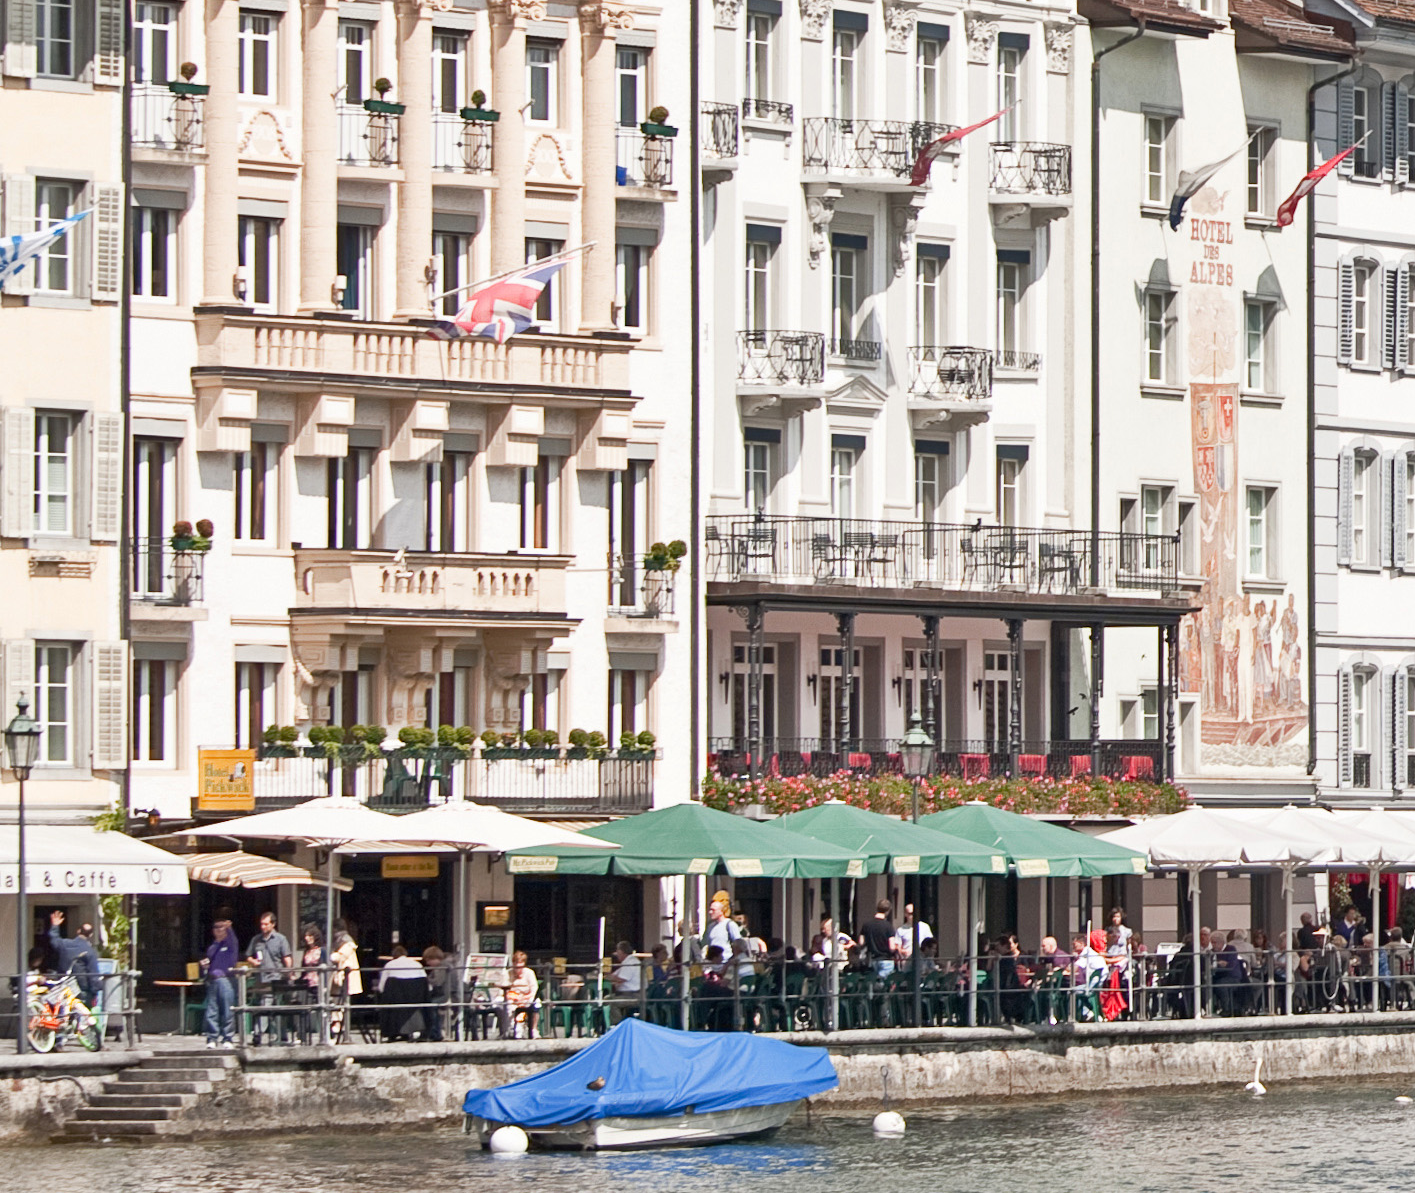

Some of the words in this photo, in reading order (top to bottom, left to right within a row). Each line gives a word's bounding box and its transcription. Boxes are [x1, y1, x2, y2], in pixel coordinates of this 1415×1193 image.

[1190, 218, 1234, 244] HOTEL
[1203, 244, 1220, 260] DES
[1190, 260, 1234, 287] ALPES
[43, 870, 53, 887] &
[65, 870, 117, 888] Caffè
